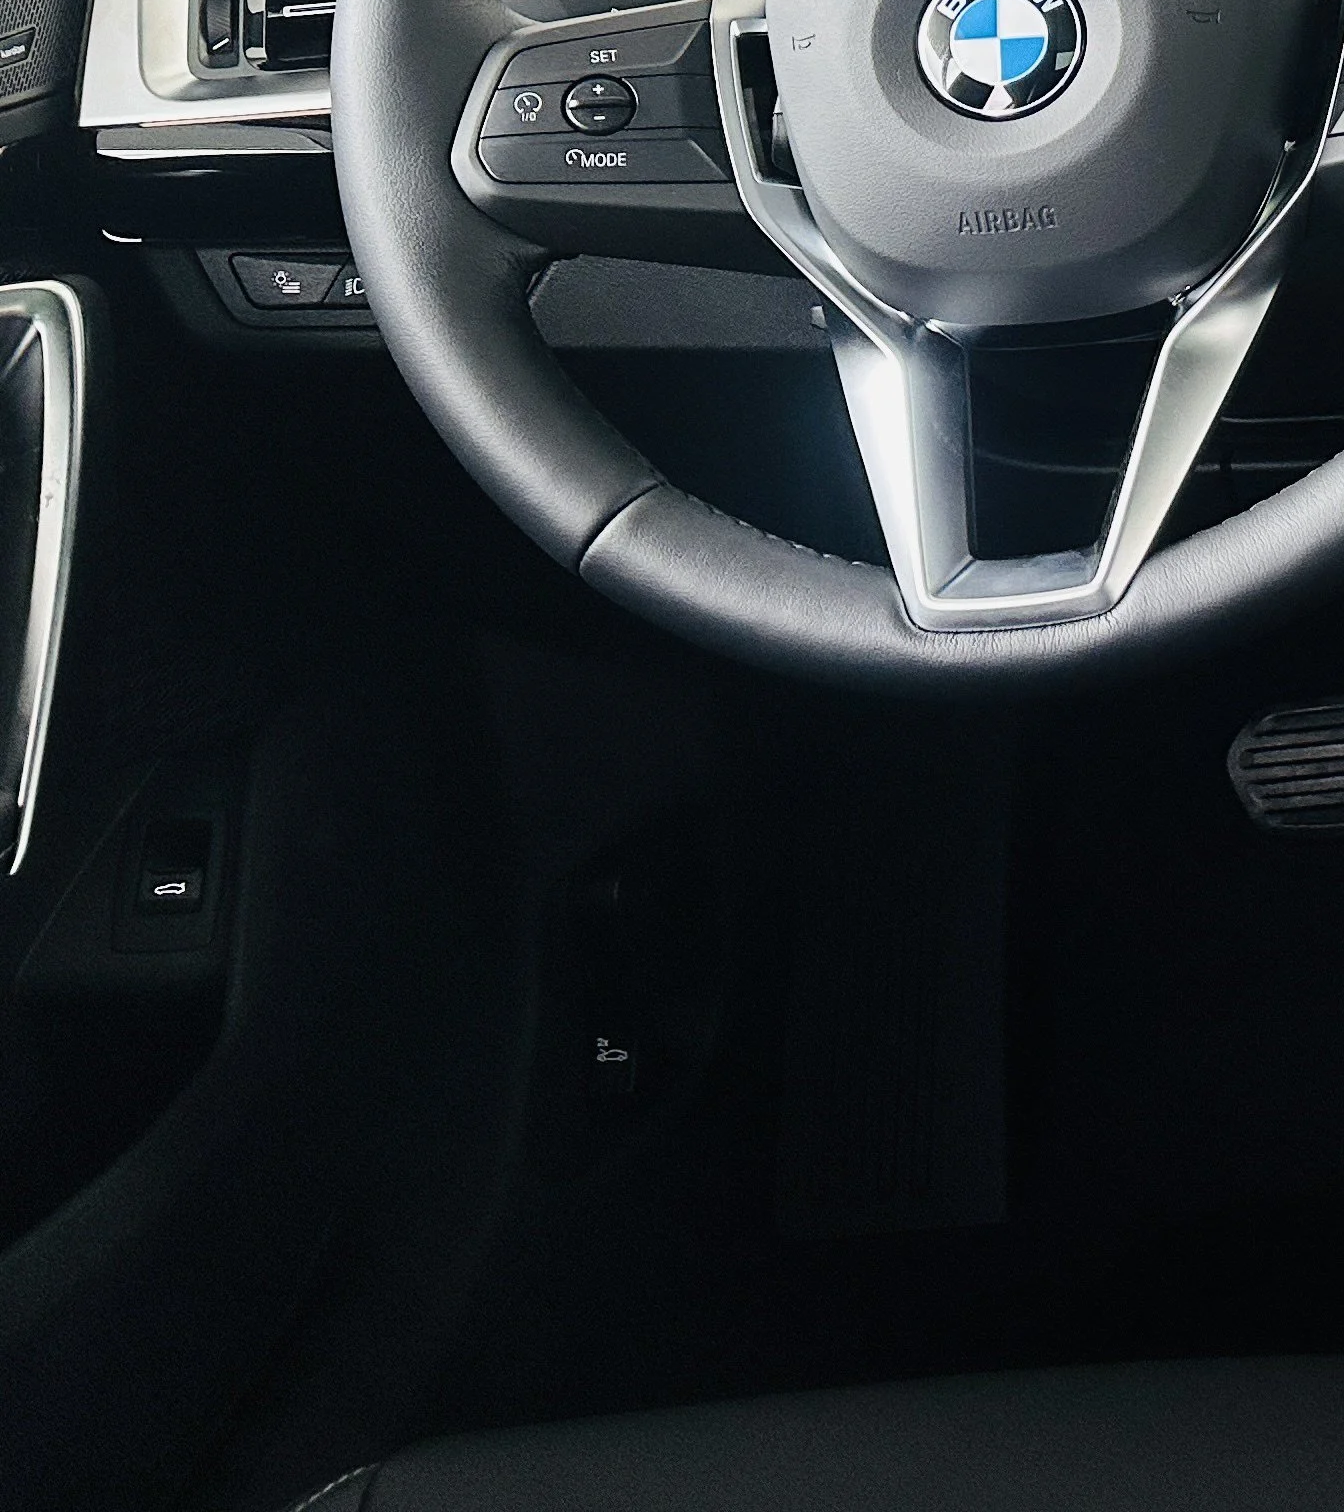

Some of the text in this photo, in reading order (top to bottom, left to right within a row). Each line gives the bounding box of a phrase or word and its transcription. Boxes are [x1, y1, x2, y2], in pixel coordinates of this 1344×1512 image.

[590, 49, 618, 64] SET
[580, 152, 627, 168] MODE
[958, 205, 1059, 237] AIRBAG
